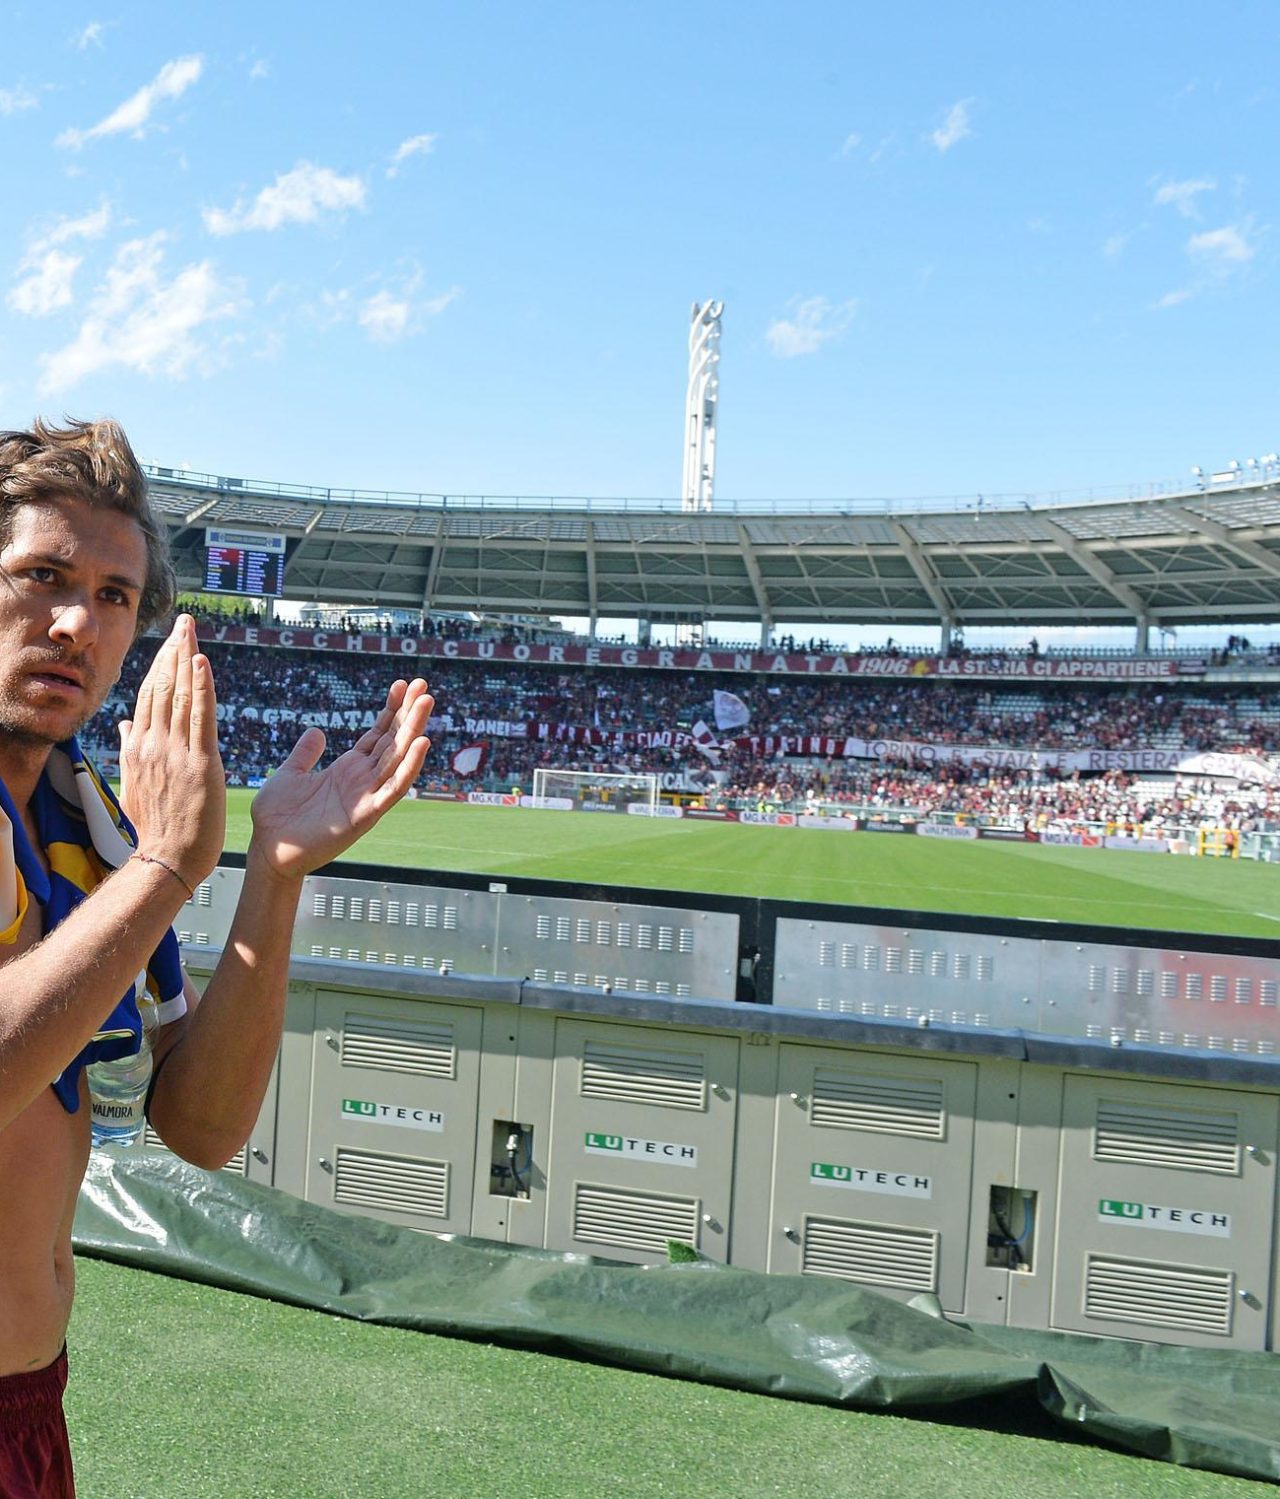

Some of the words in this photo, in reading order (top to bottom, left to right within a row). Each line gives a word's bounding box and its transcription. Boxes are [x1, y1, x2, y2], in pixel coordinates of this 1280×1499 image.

[857, 658, 910, 674] 1906
[938, 660, 959, 673] LA
[1032, 661, 1052, 675] CI
[1057, 660, 1170, 675] APPARTIENE
[93, 1103, 133, 1118] VALMORA
[344, 1100, 441, 1123] LUTECH
[588, 1134, 695, 1158] LUTECH
[814, 1164, 928, 1189] LUTECH
[1102, 1201, 1227, 1227] LUTECH
